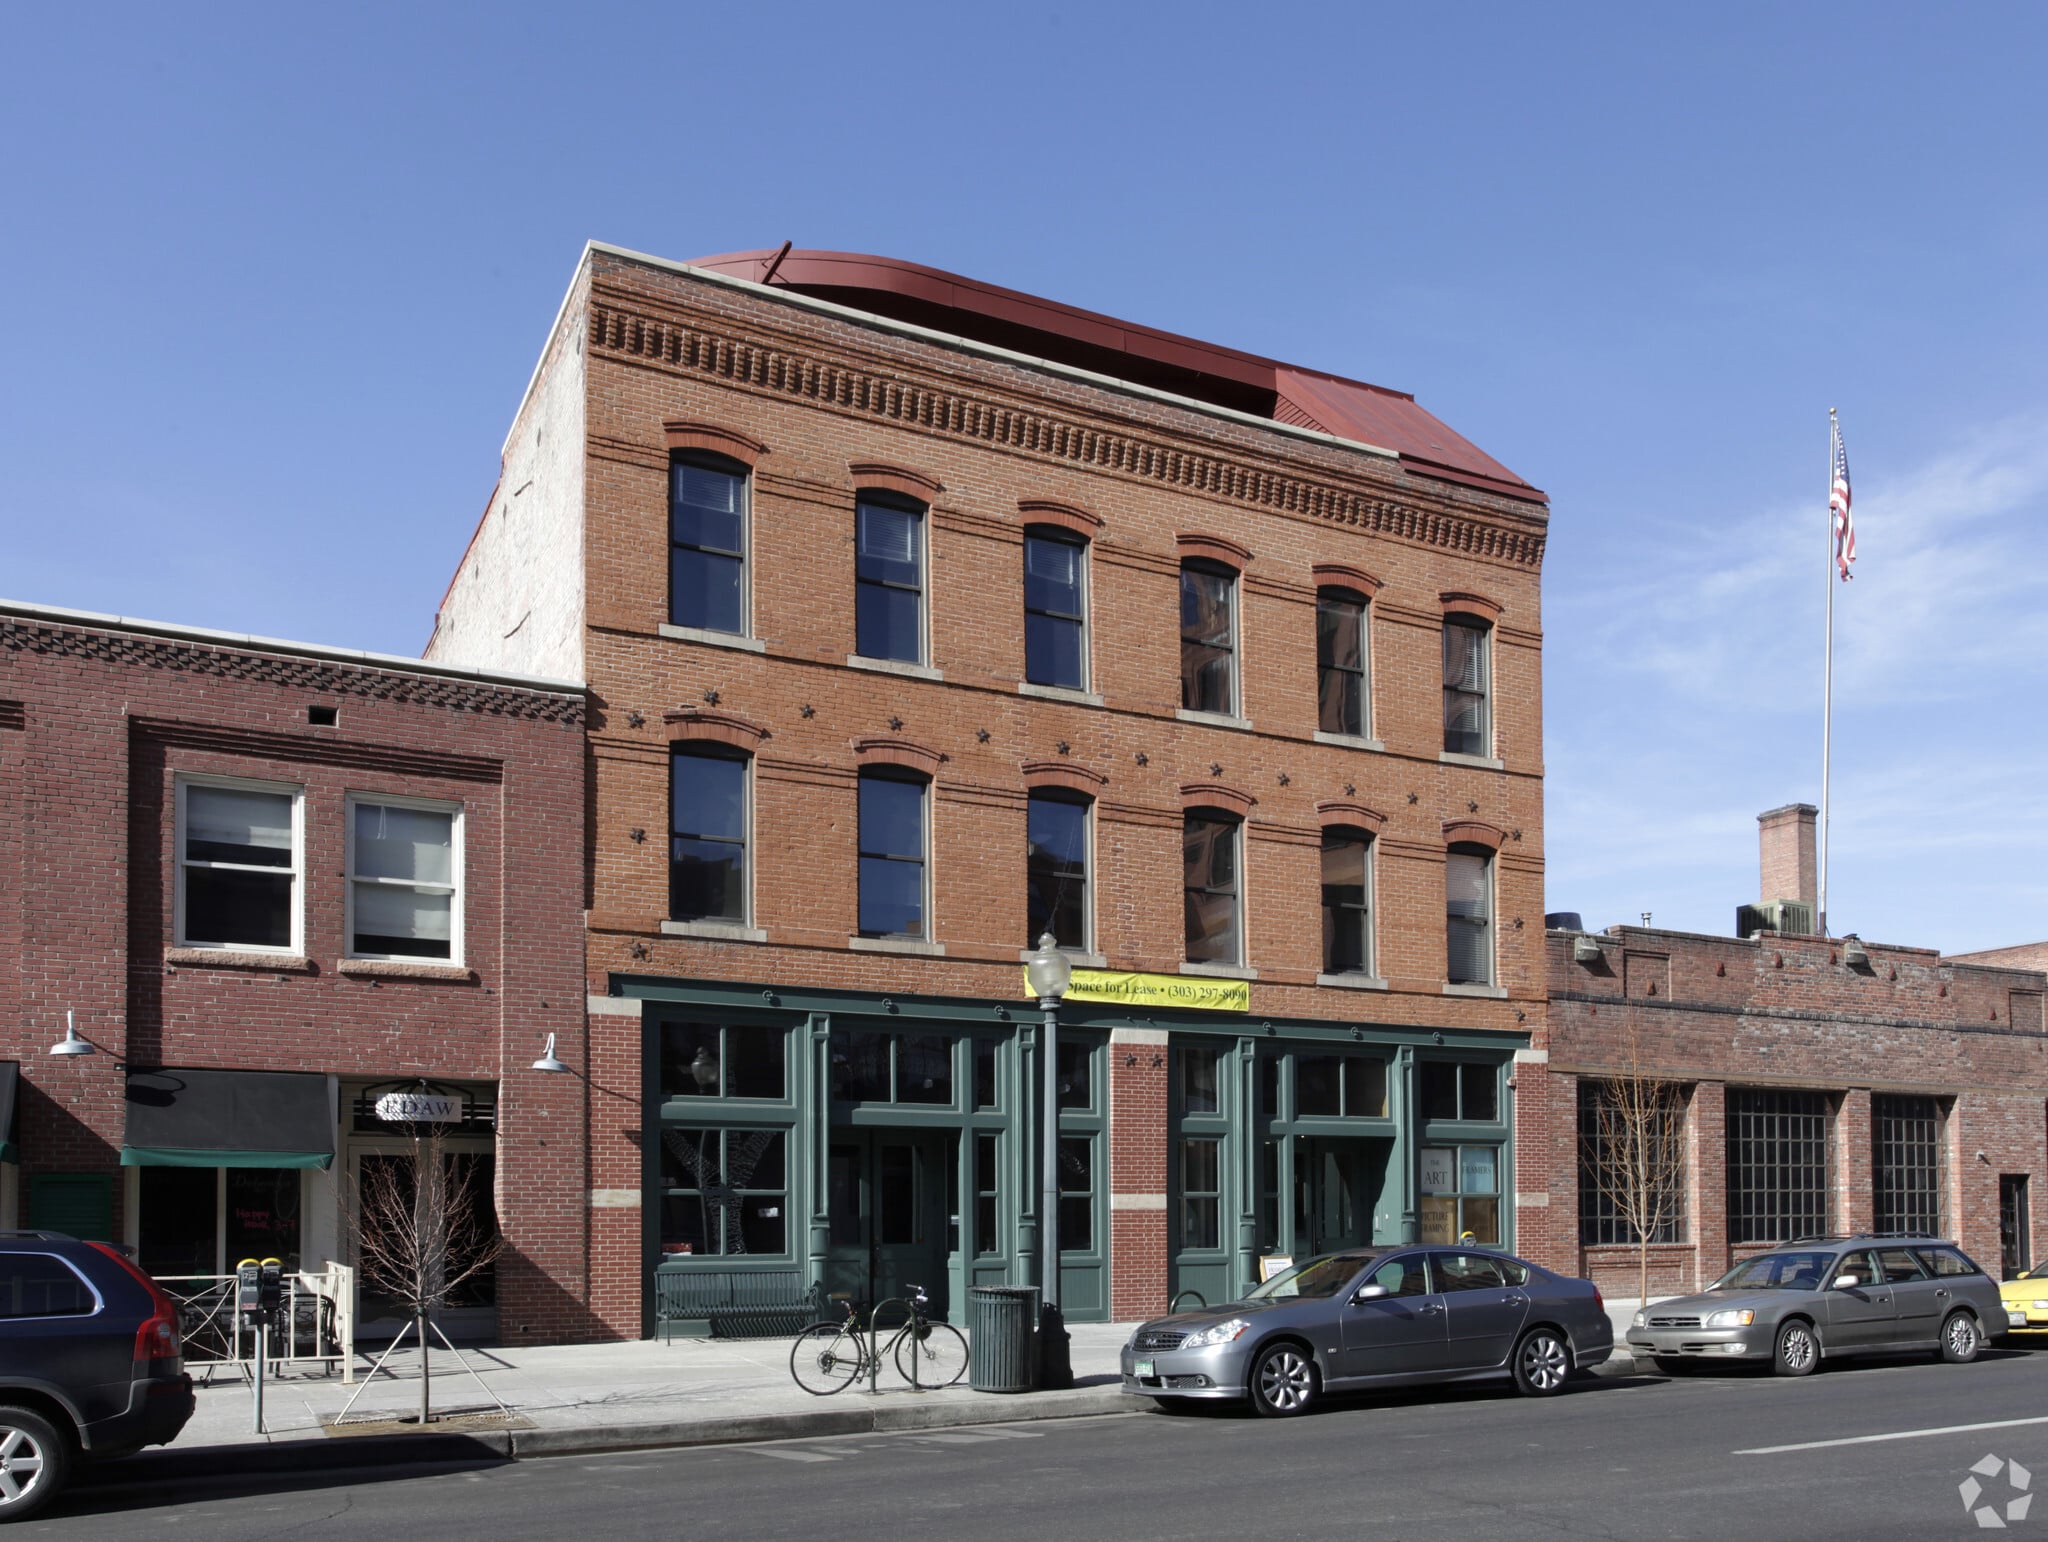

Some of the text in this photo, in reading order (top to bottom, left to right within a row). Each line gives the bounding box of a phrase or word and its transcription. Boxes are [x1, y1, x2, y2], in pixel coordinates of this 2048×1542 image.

[1068, 980, 1247, 1001] Space for Lease (303) 297-8090
[1424, 1171, 1448, 1185] ART
